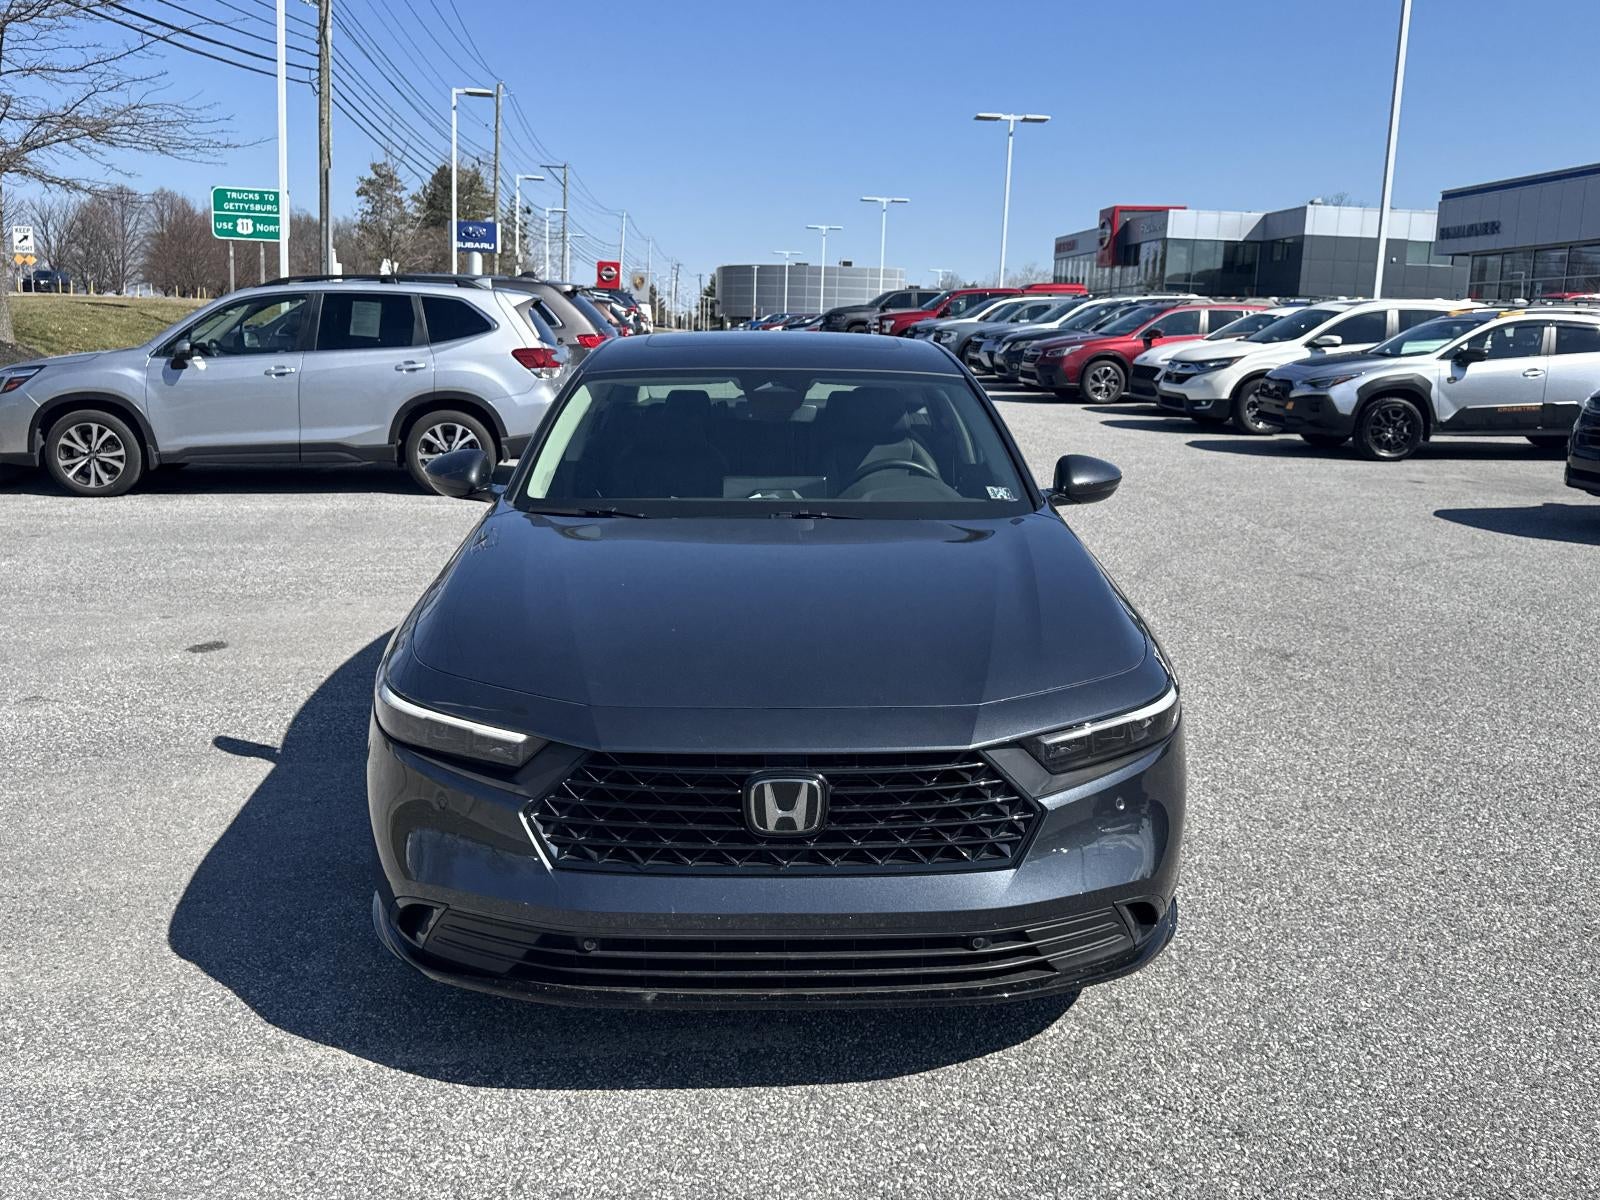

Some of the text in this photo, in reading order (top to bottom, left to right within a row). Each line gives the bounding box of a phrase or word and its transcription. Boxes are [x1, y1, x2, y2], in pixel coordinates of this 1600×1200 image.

[226, 191, 275, 202] TRUCKS TO
[223, 202, 278, 212] GETTYSBURG
[216, 221, 280, 233] USE 11 NORT
